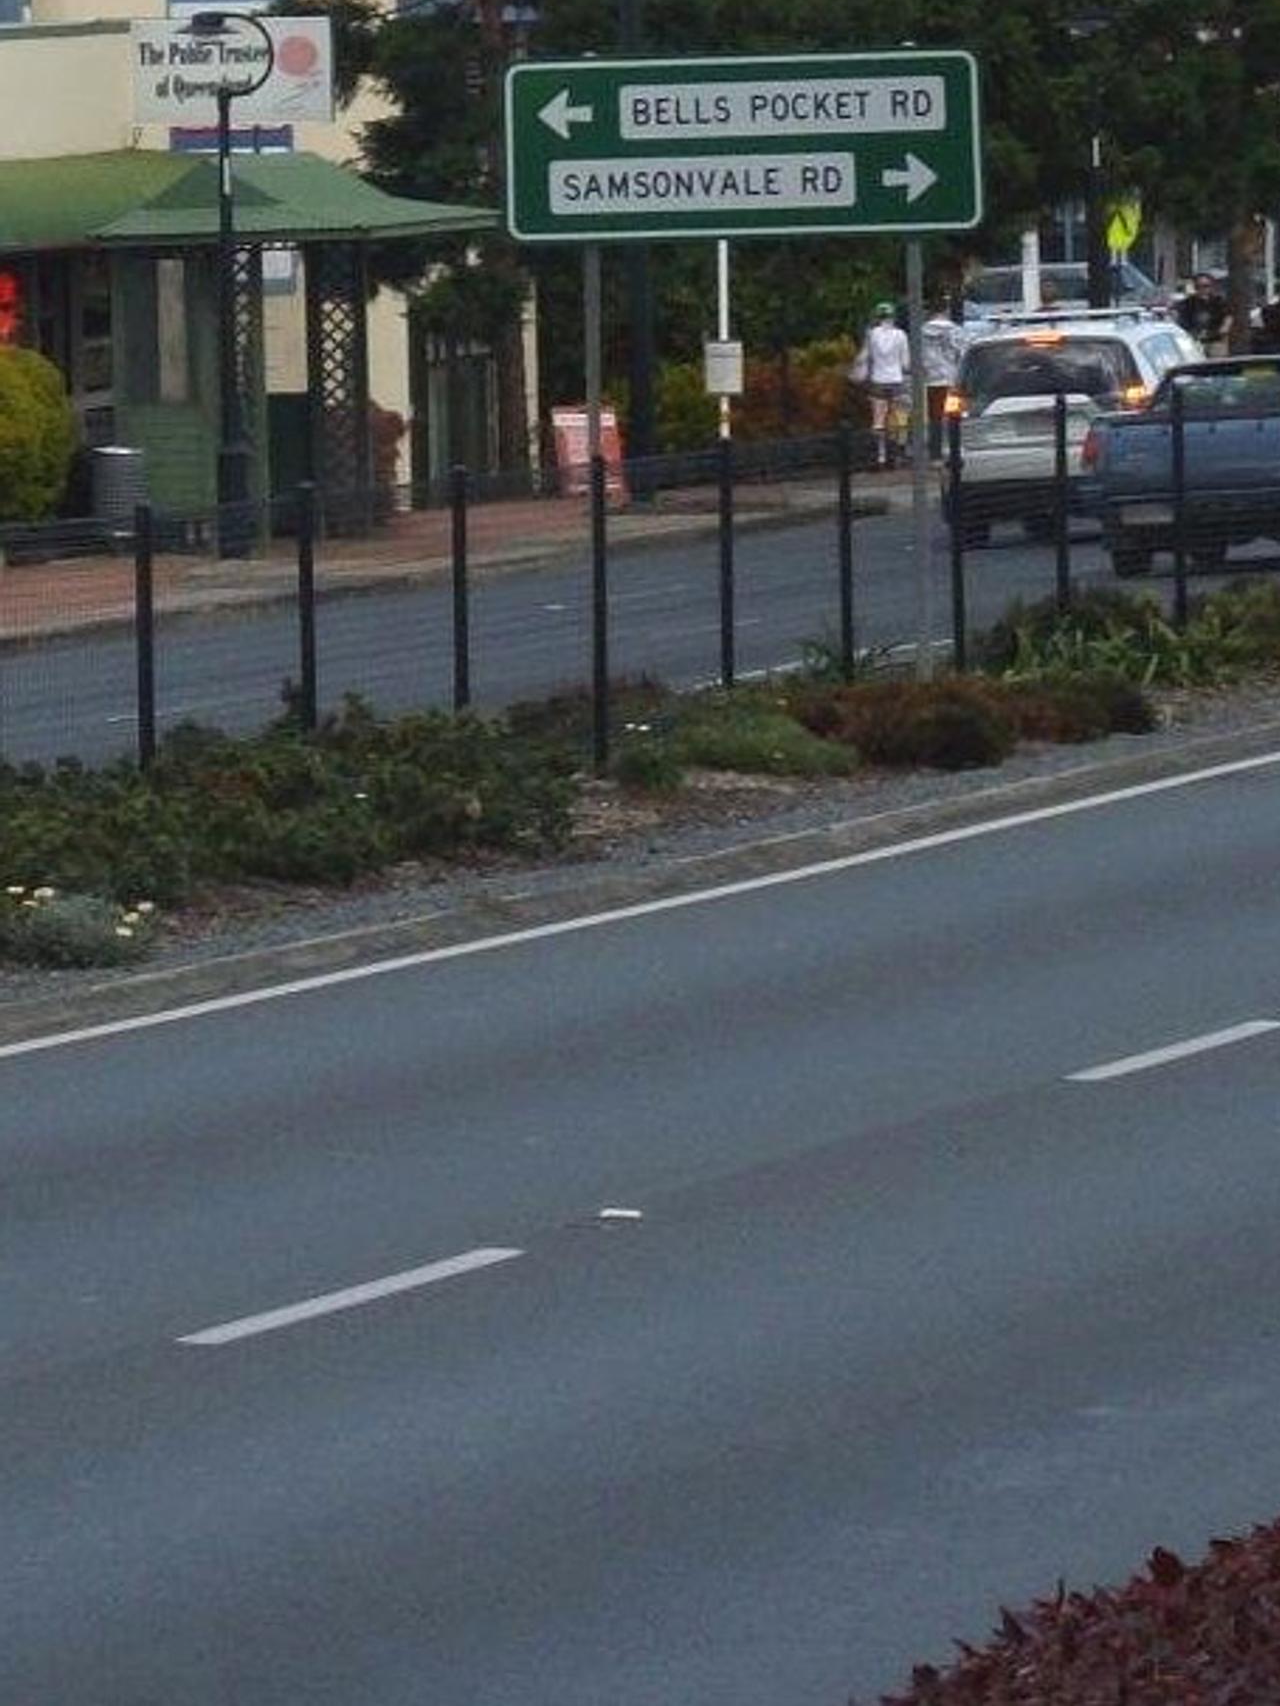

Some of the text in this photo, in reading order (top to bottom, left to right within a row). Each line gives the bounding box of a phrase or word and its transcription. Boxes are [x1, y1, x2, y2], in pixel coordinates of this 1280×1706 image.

[139, 41, 164, 66] The
[631, 89, 933, 126] BELLS POCKET RD
[562, 165, 843, 202] SAMSONVALE RD
